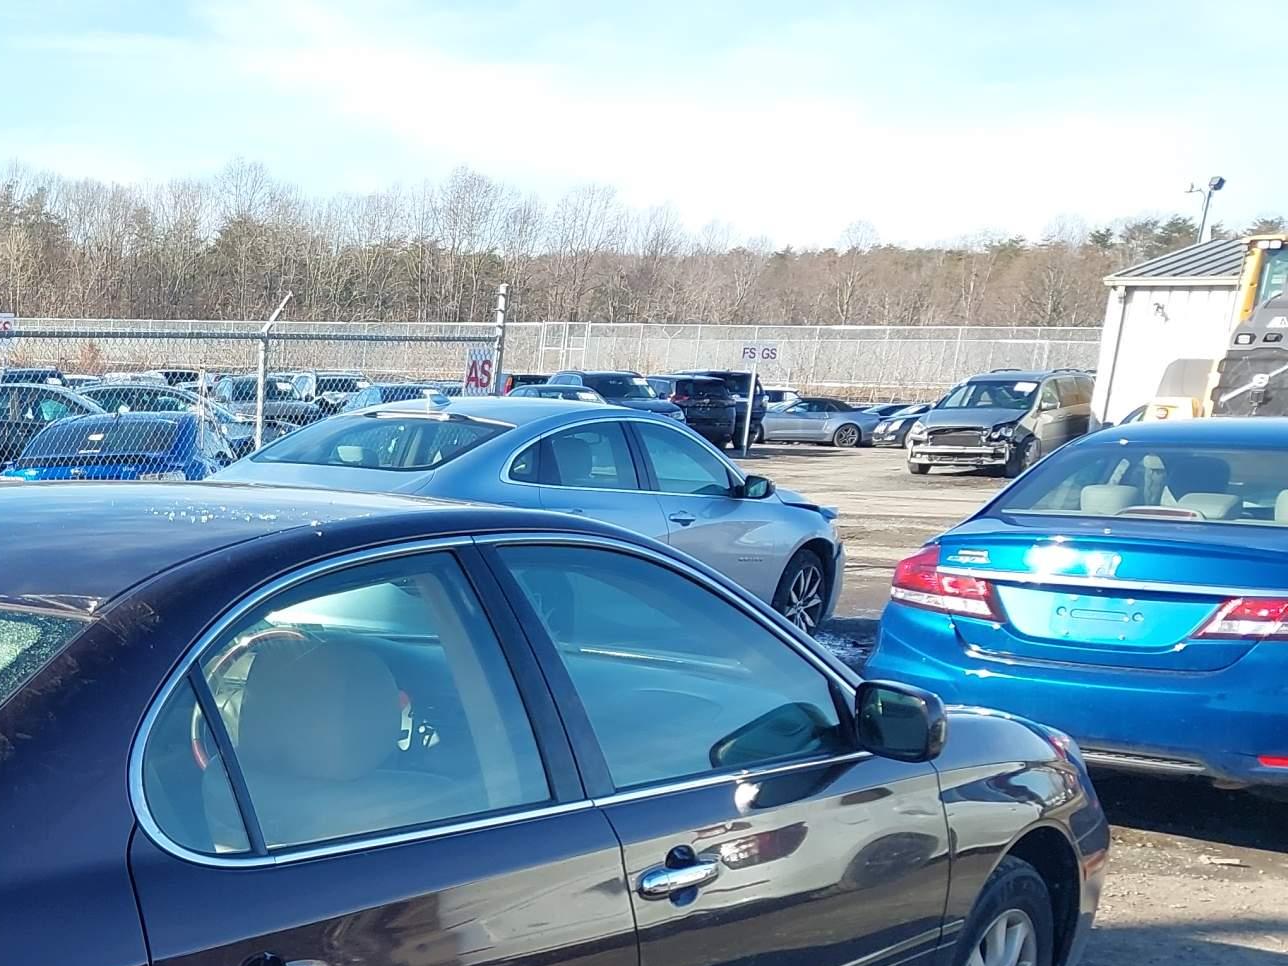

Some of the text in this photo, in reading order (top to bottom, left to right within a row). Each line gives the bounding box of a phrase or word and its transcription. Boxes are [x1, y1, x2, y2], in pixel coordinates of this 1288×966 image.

[742, 347, 777, 359] FS GS
[466, 360, 492, 388] AS
